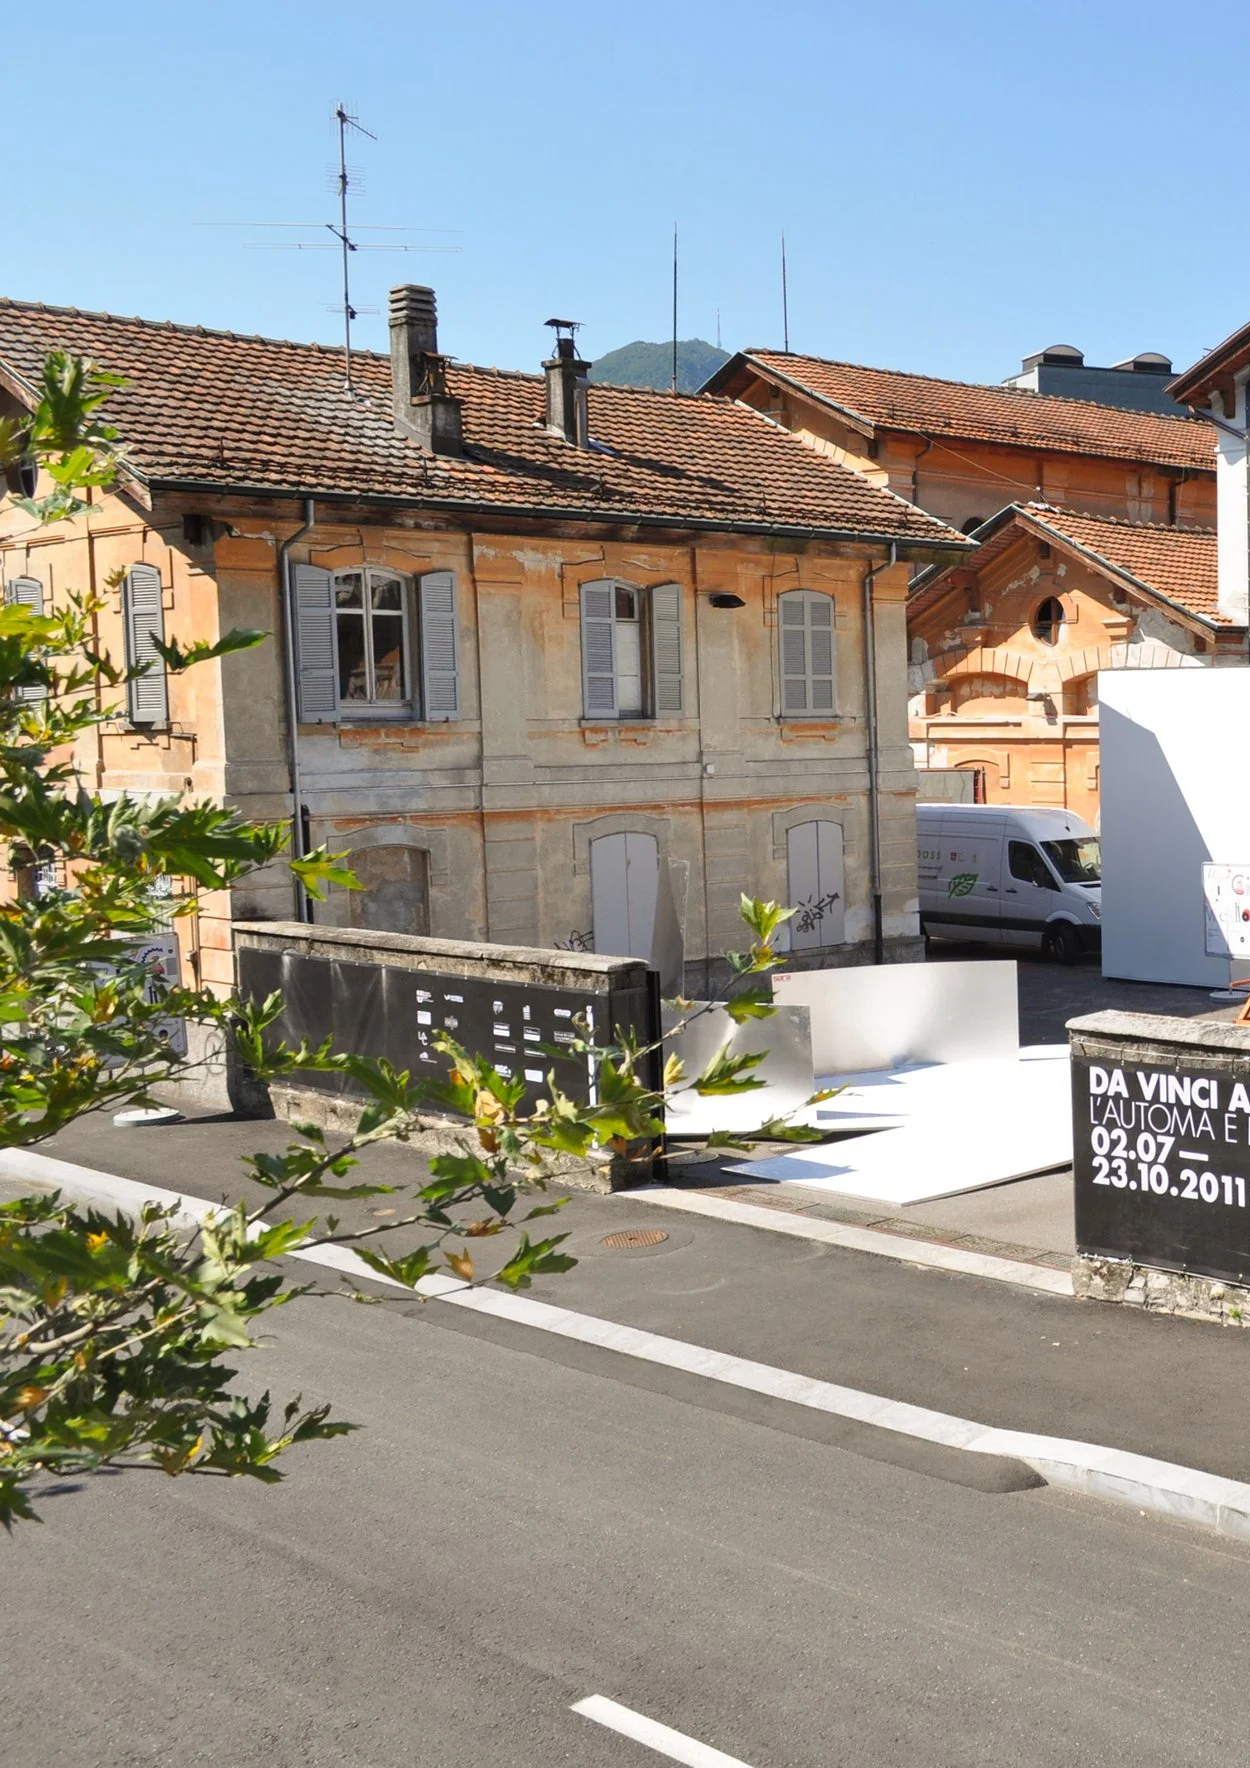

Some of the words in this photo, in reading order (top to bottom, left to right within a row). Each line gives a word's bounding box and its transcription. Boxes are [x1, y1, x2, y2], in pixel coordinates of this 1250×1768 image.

[1089, 1066, 1128, 1098] DA
[1136, 1071, 1217, 1109] VINCI
[1090, 1097, 1215, 1140] L'AUTOMA
[1225, 1114, 1237, 1143] E
[1091, 1156, 1245, 1207] 23.10.2011
